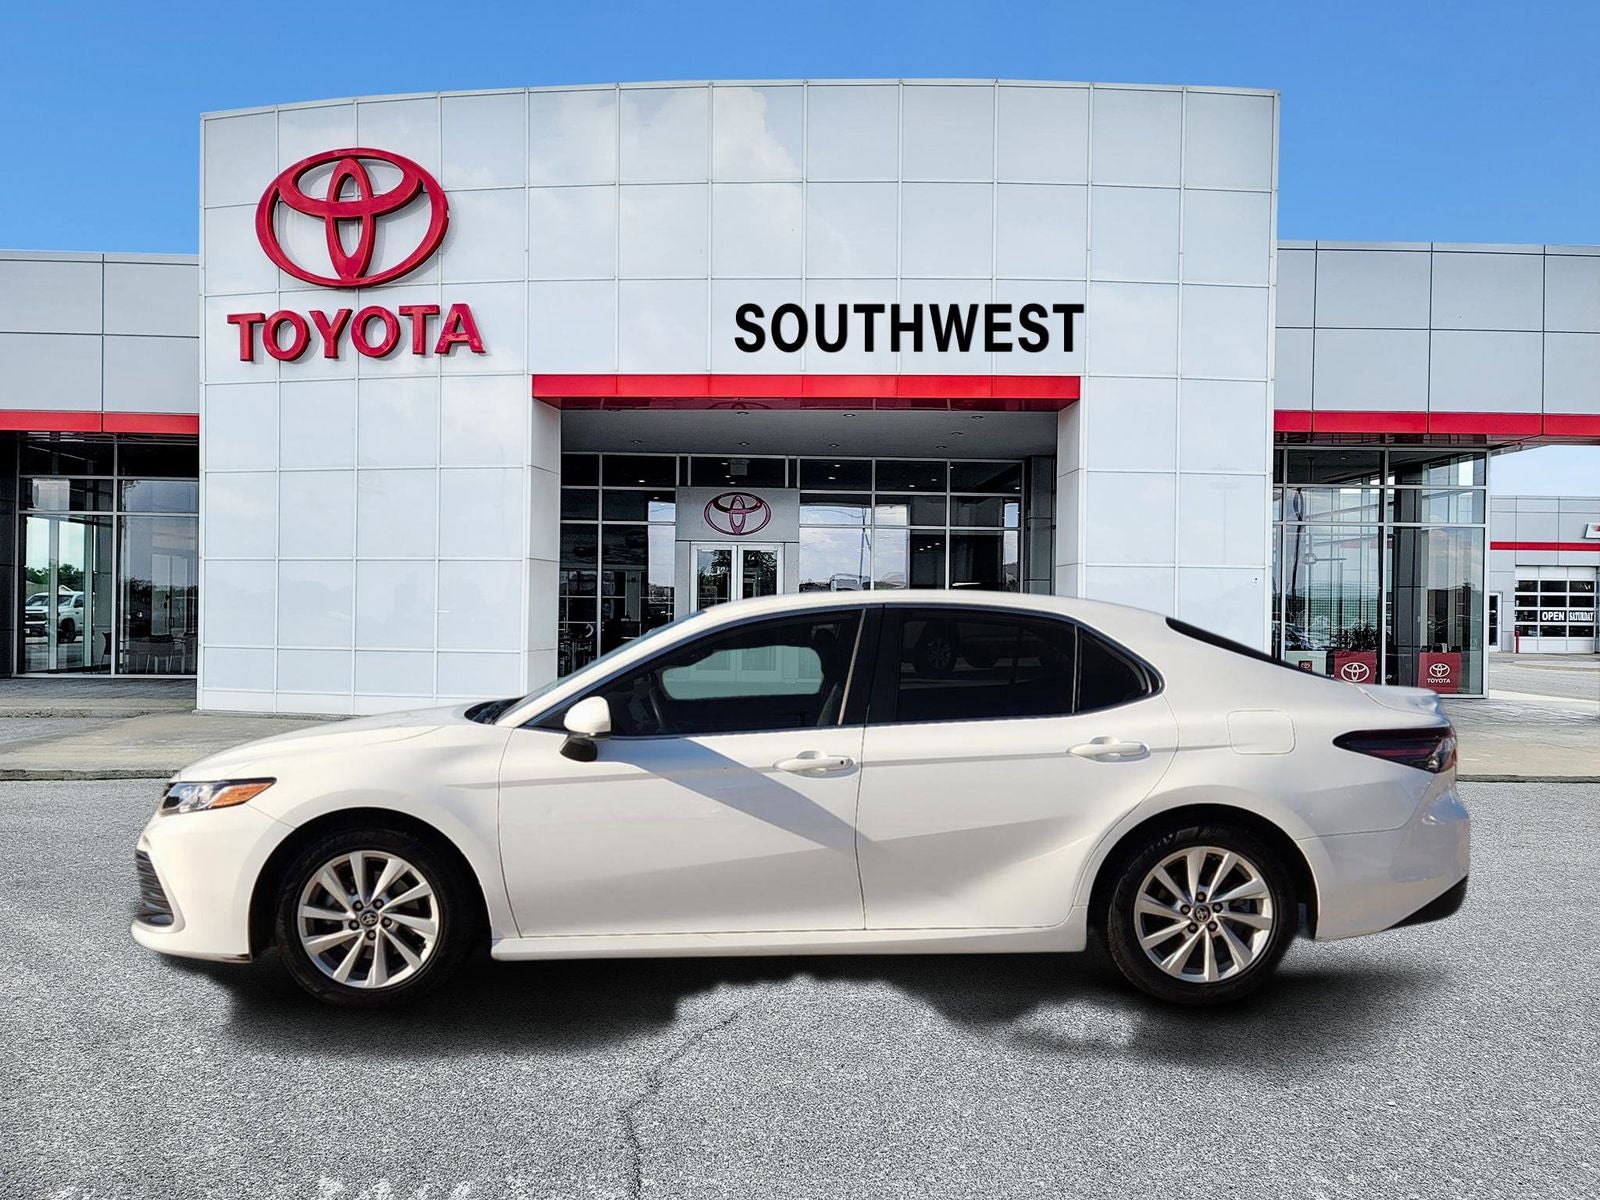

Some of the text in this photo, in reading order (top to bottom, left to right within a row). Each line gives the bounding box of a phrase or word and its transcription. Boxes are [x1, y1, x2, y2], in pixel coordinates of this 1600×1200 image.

[227, 303, 485, 362] TOYOTA
[734, 303, 1085, 353] SOUTHWEST
[1542, 611, 1565, 621] OPEN
